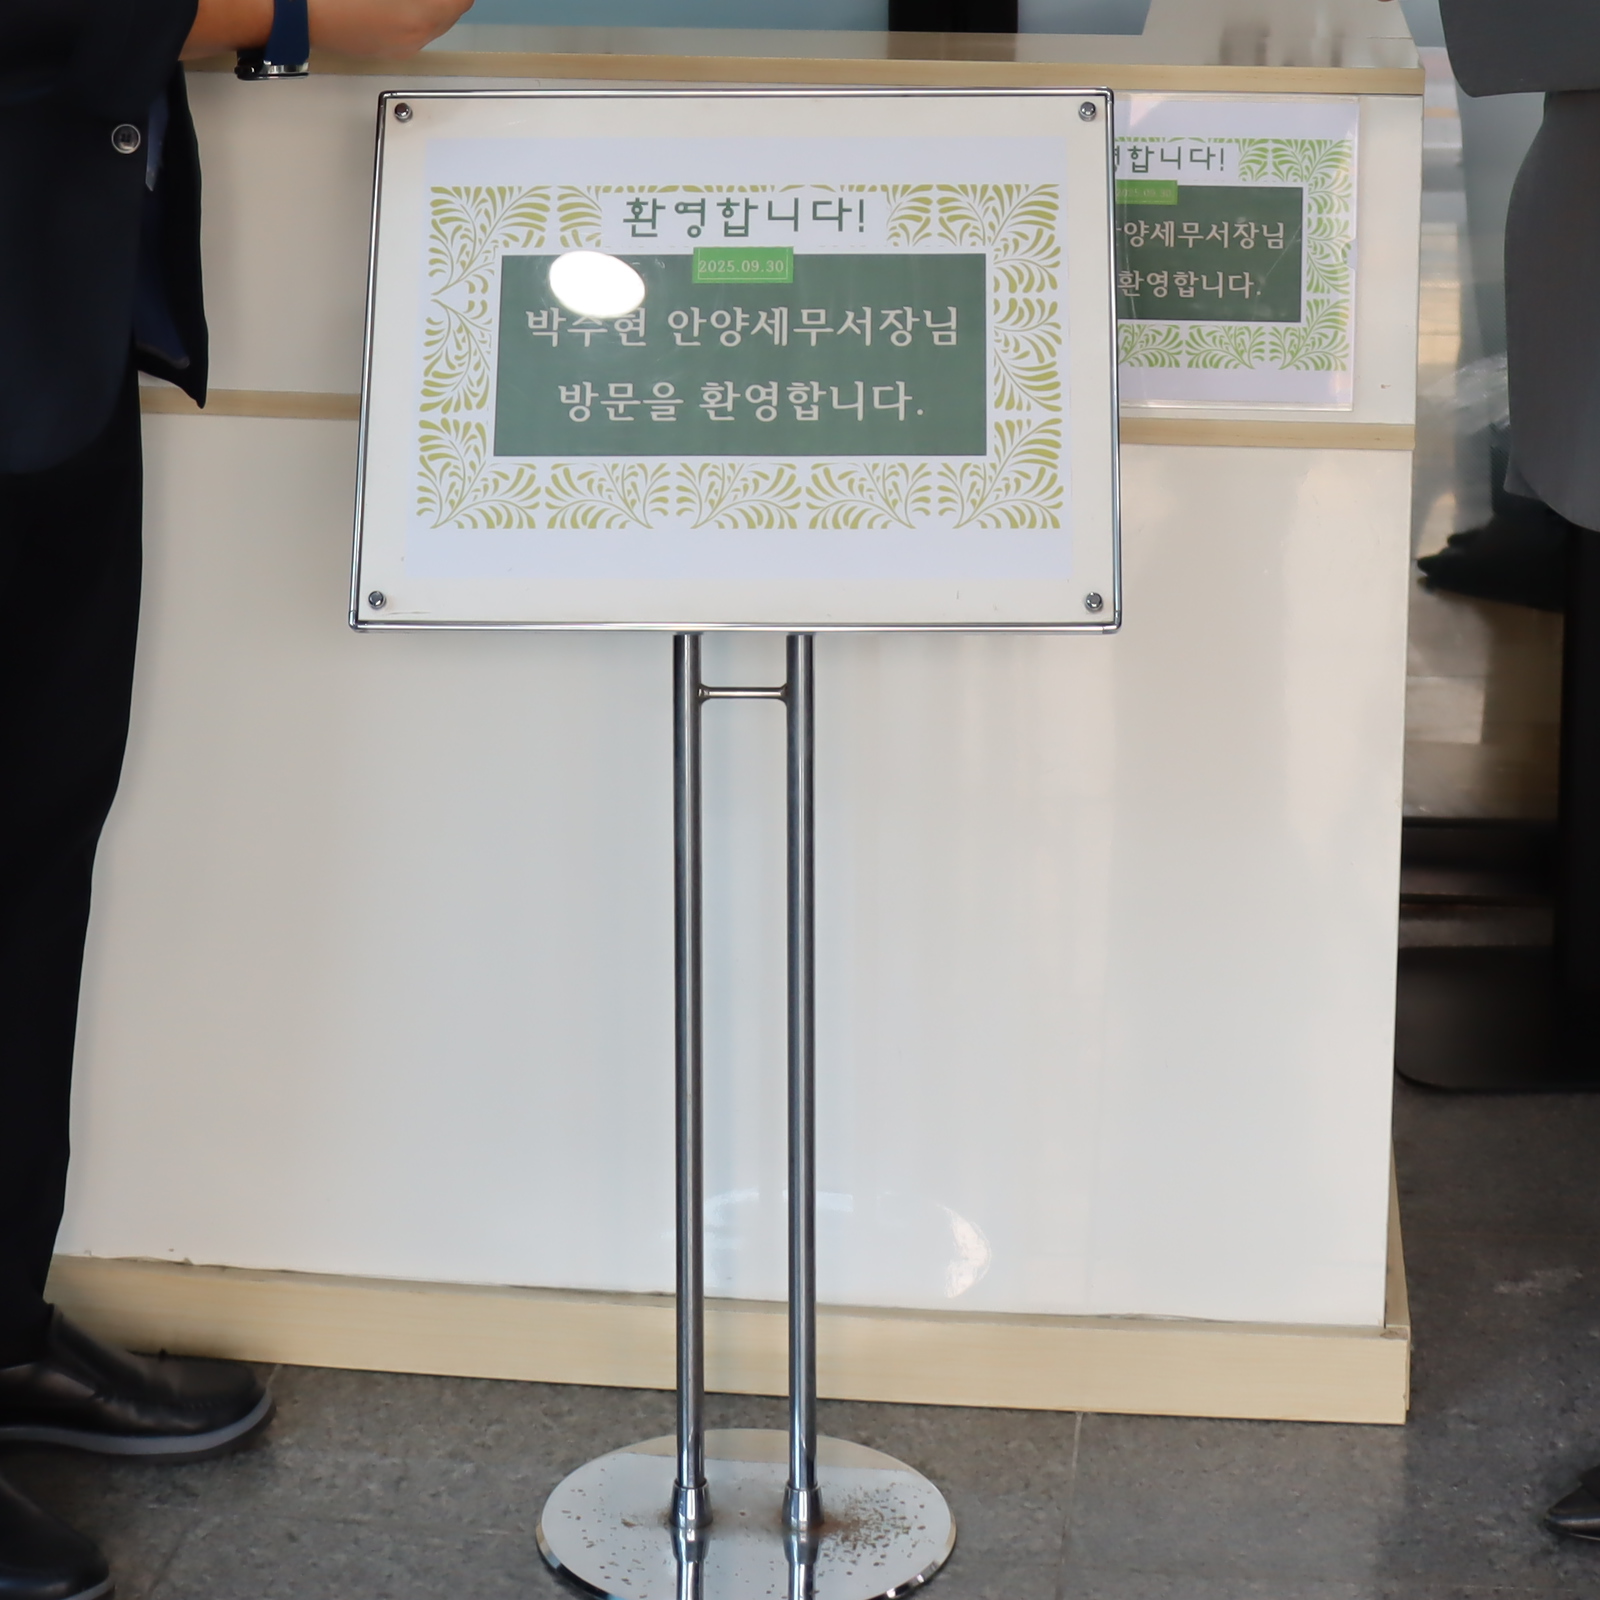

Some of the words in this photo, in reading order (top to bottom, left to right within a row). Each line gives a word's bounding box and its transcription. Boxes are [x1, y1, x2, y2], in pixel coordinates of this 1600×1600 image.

[622, 196, 867, 239] 환영합니다!
[1116, 219, 1285, 250] 양세무서장님
[698, 260, 785, 274] 2025.09.30
[1117, 269, 1262, 299] 환영합니다.
[667, 305, 960, 348] 안양세무서장님
[558, 381, 685, 423] 방문을
[698, 381, 925, 423] 환영합니다.
